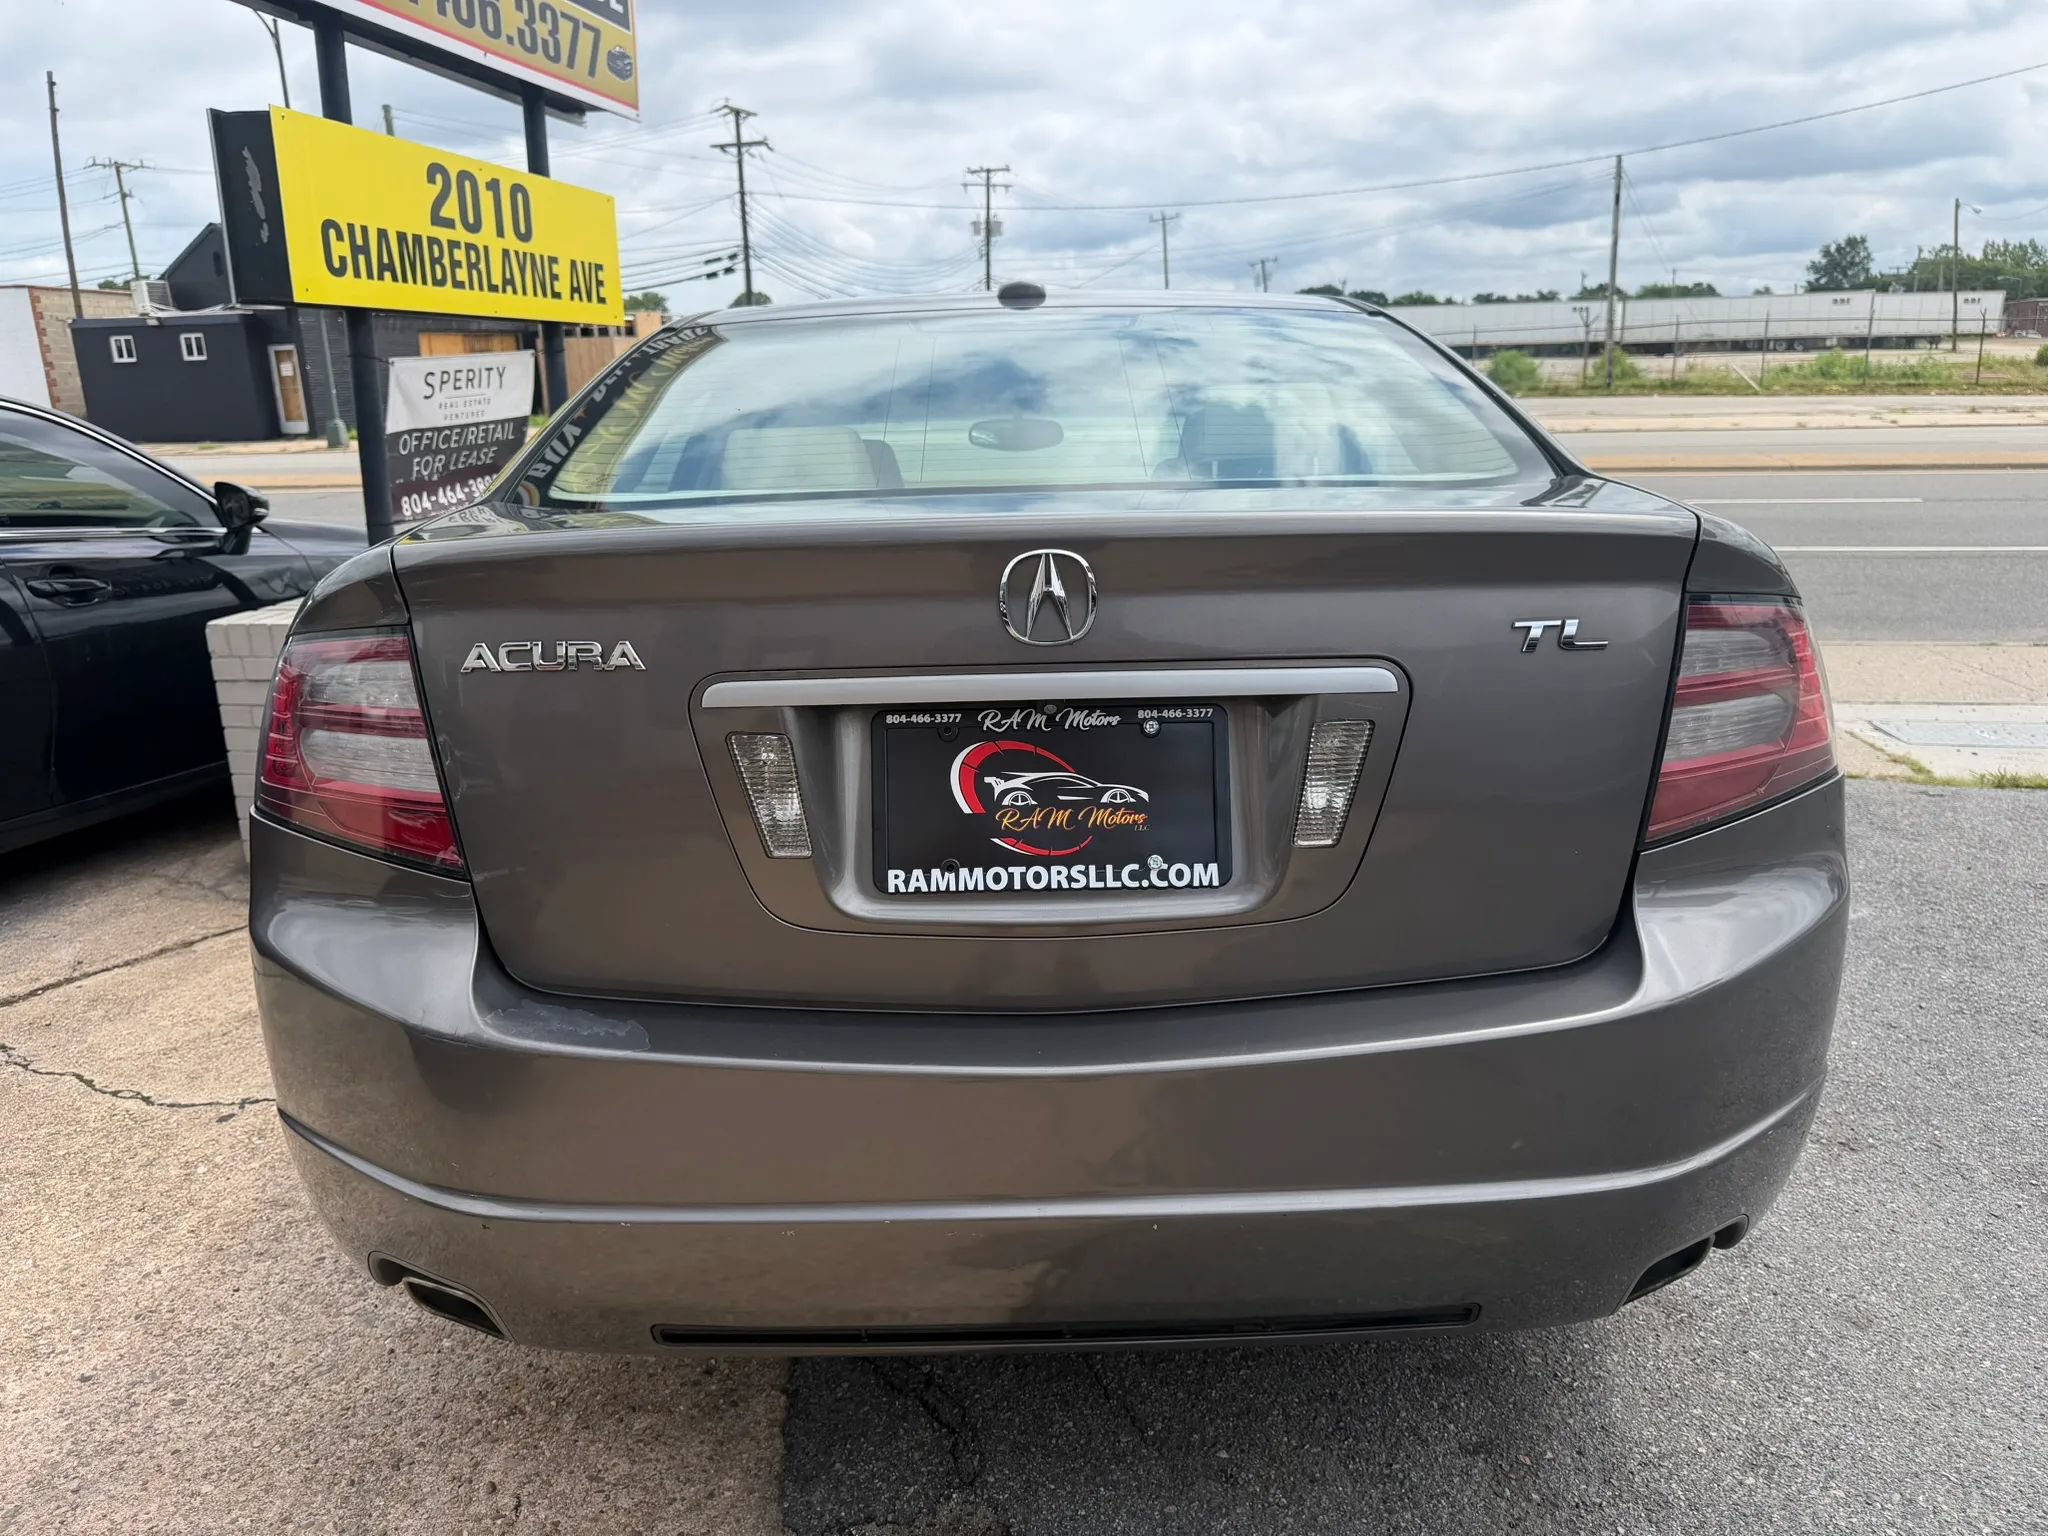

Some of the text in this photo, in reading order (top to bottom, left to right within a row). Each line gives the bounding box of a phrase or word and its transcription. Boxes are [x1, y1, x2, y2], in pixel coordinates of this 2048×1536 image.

[426, 162, 533, 243] 2010
[320, 218, 607, 305] CHAMBERLAYNE AVE
[423, 366, 507, 400] SPERITY
[399, 422, 515, 455] OFFICE/RETAIL
[411, 446, 498, 480] FOR LEASE
[401, 473, 498, 516] 804-464-38
[1511, 618, 1609, 653] TL
[460, 640, 647, 673] ACURA
[886, 713, 962, 724] 804-466-3377
[977, 707, 1122, 732] RAM Motors
[1137, 708, 1214, 719] 804-466-3377
[995, 806, 1148, 832] RAM Motors
[886, 863, 1220, 894] RAMMOTORSLLC.COM
